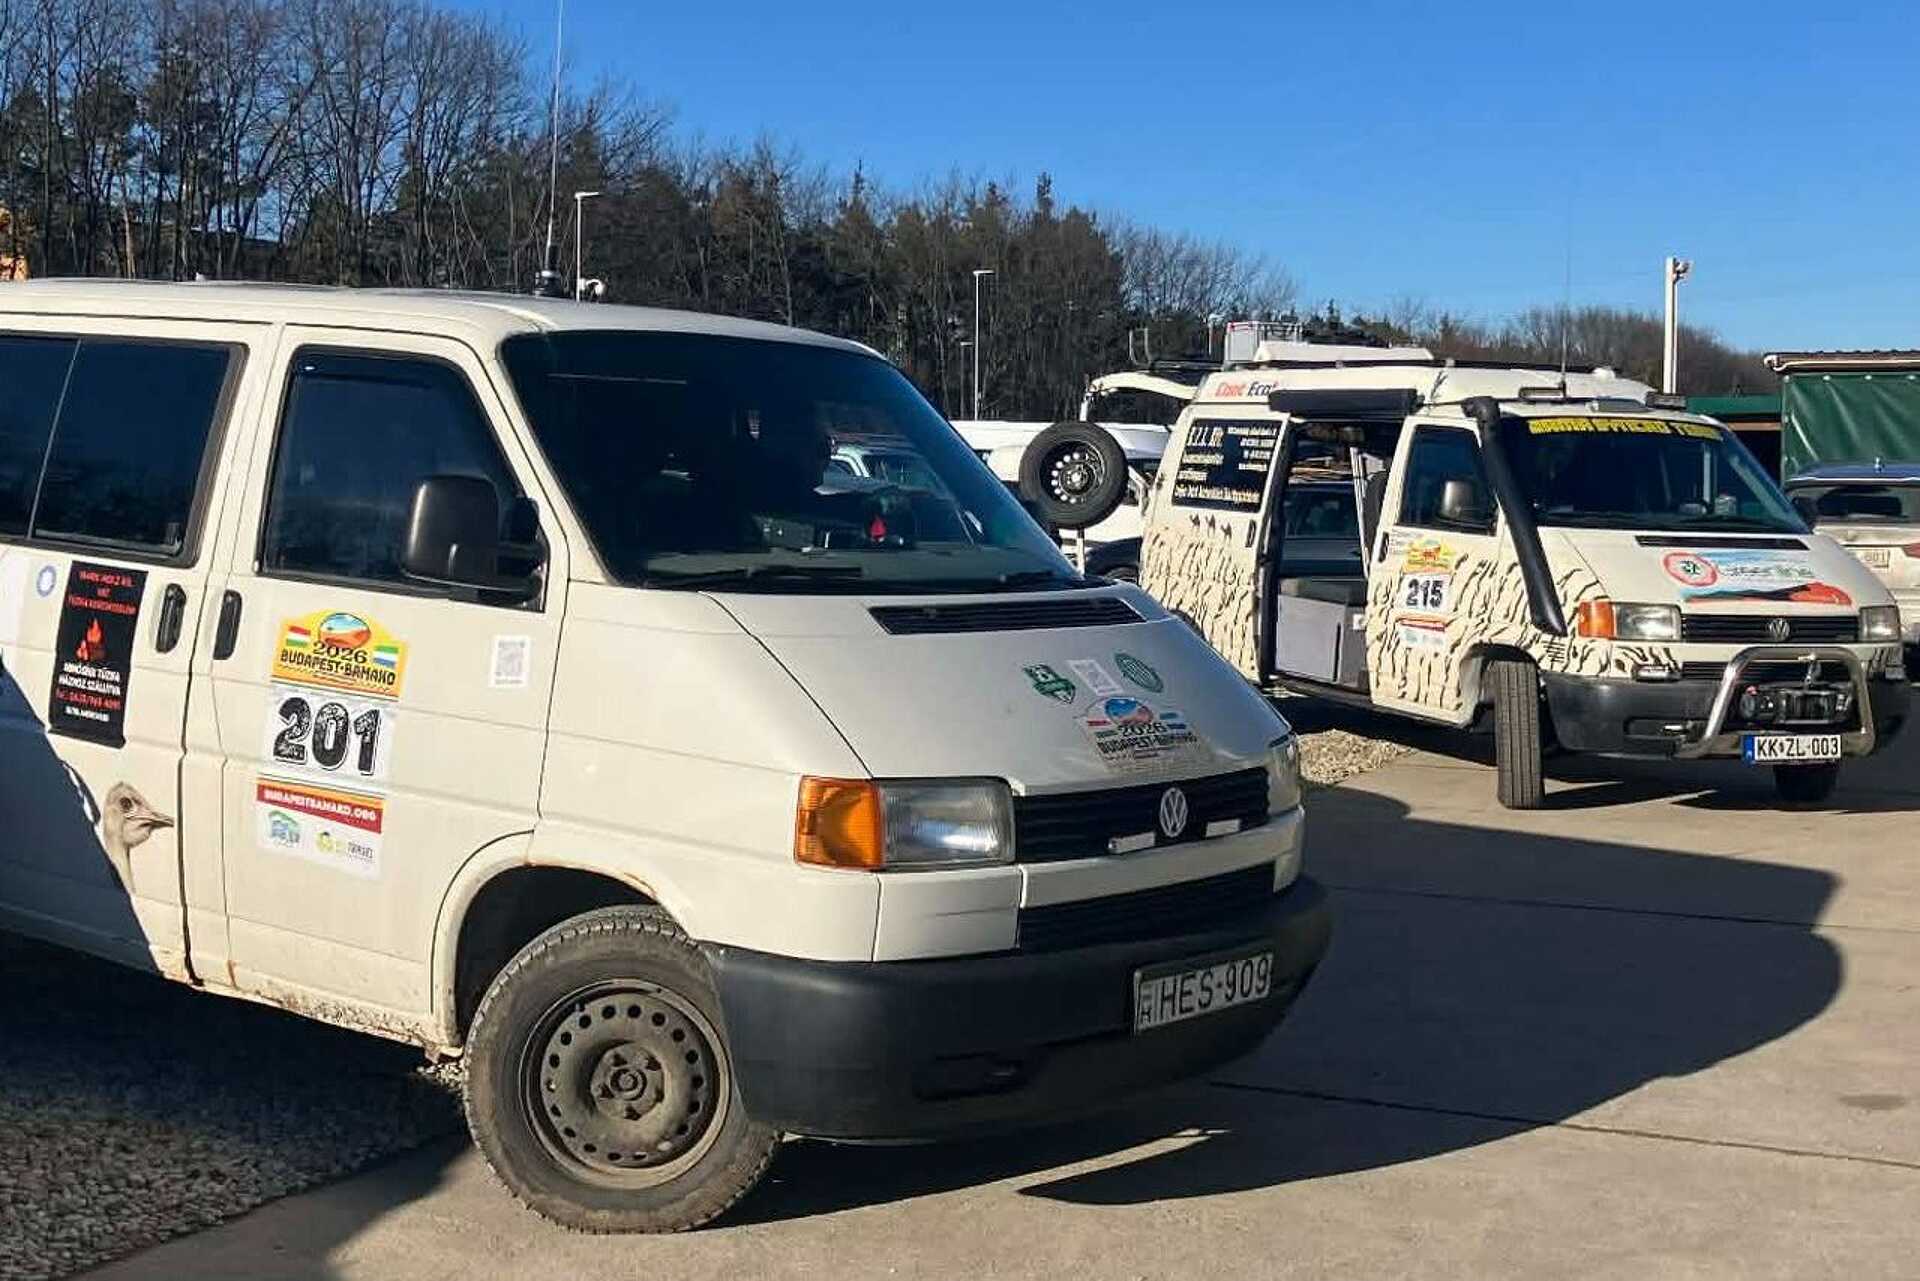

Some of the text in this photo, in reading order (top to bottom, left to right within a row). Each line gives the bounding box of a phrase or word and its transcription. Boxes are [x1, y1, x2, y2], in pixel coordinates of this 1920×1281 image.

[1406, 579, 1443, 608] 215
[313, 640, 368, 664] 2026
[273, 697, 382, 776] 201
[1118, 722, 1167, 736] 2026
[1160, 956, 1269, 1022] HES-909
